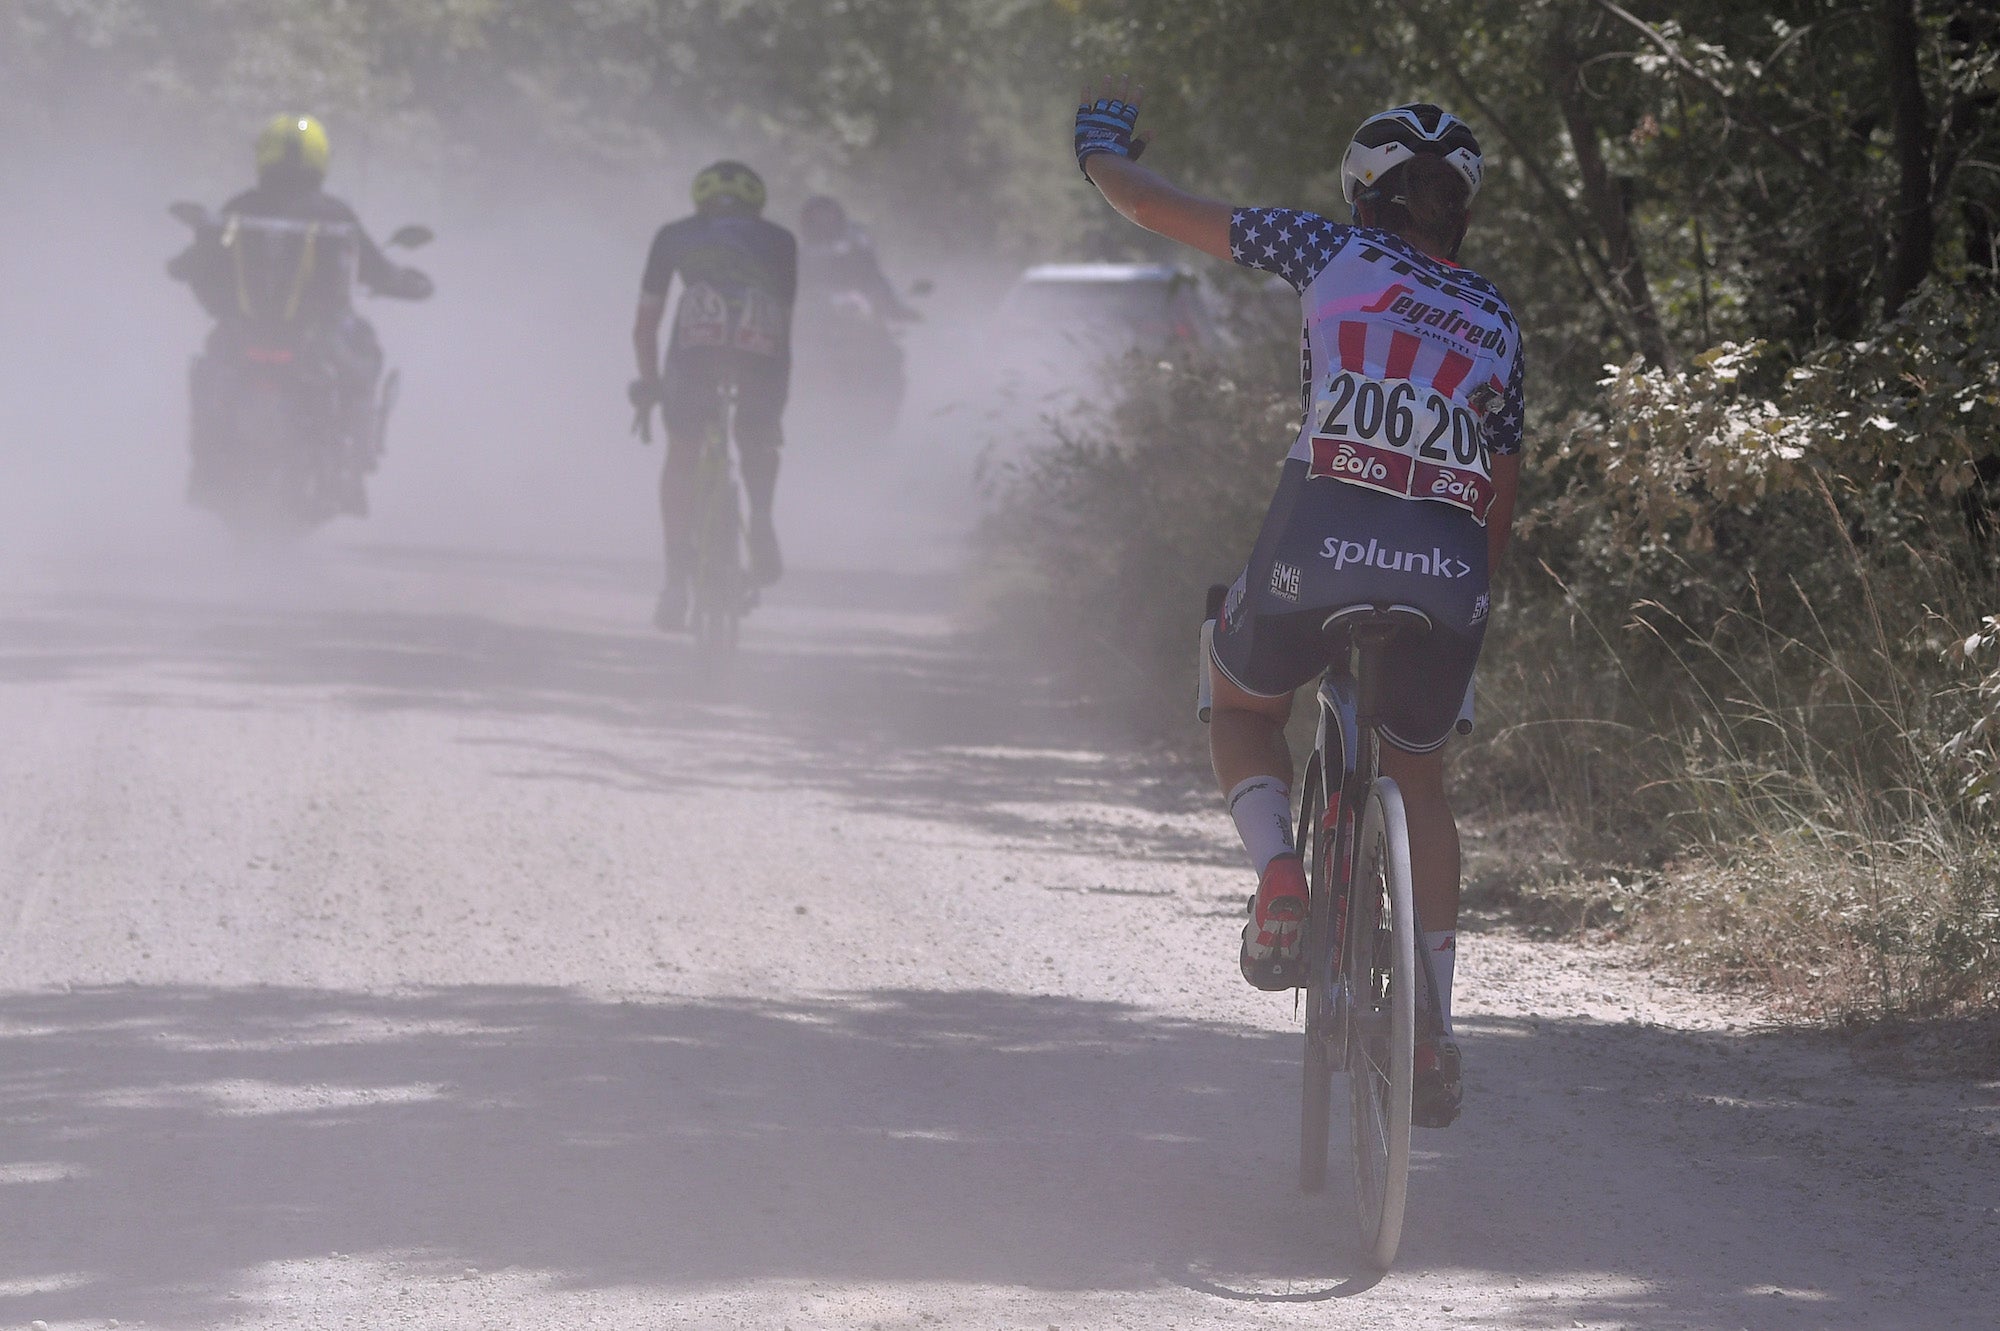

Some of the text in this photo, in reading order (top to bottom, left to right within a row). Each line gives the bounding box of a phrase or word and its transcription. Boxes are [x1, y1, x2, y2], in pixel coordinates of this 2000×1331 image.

[1358, 242, 1514, 334] TREK
[1361, 283, 1507, 358] Segafredo
[1413, 326, 1470, 354] ZANETTI
[1320, 373, 1416, 447] 206
[1332, 452, 1388, 480] eolo
[1271, 562, 1301, 595] SMS
